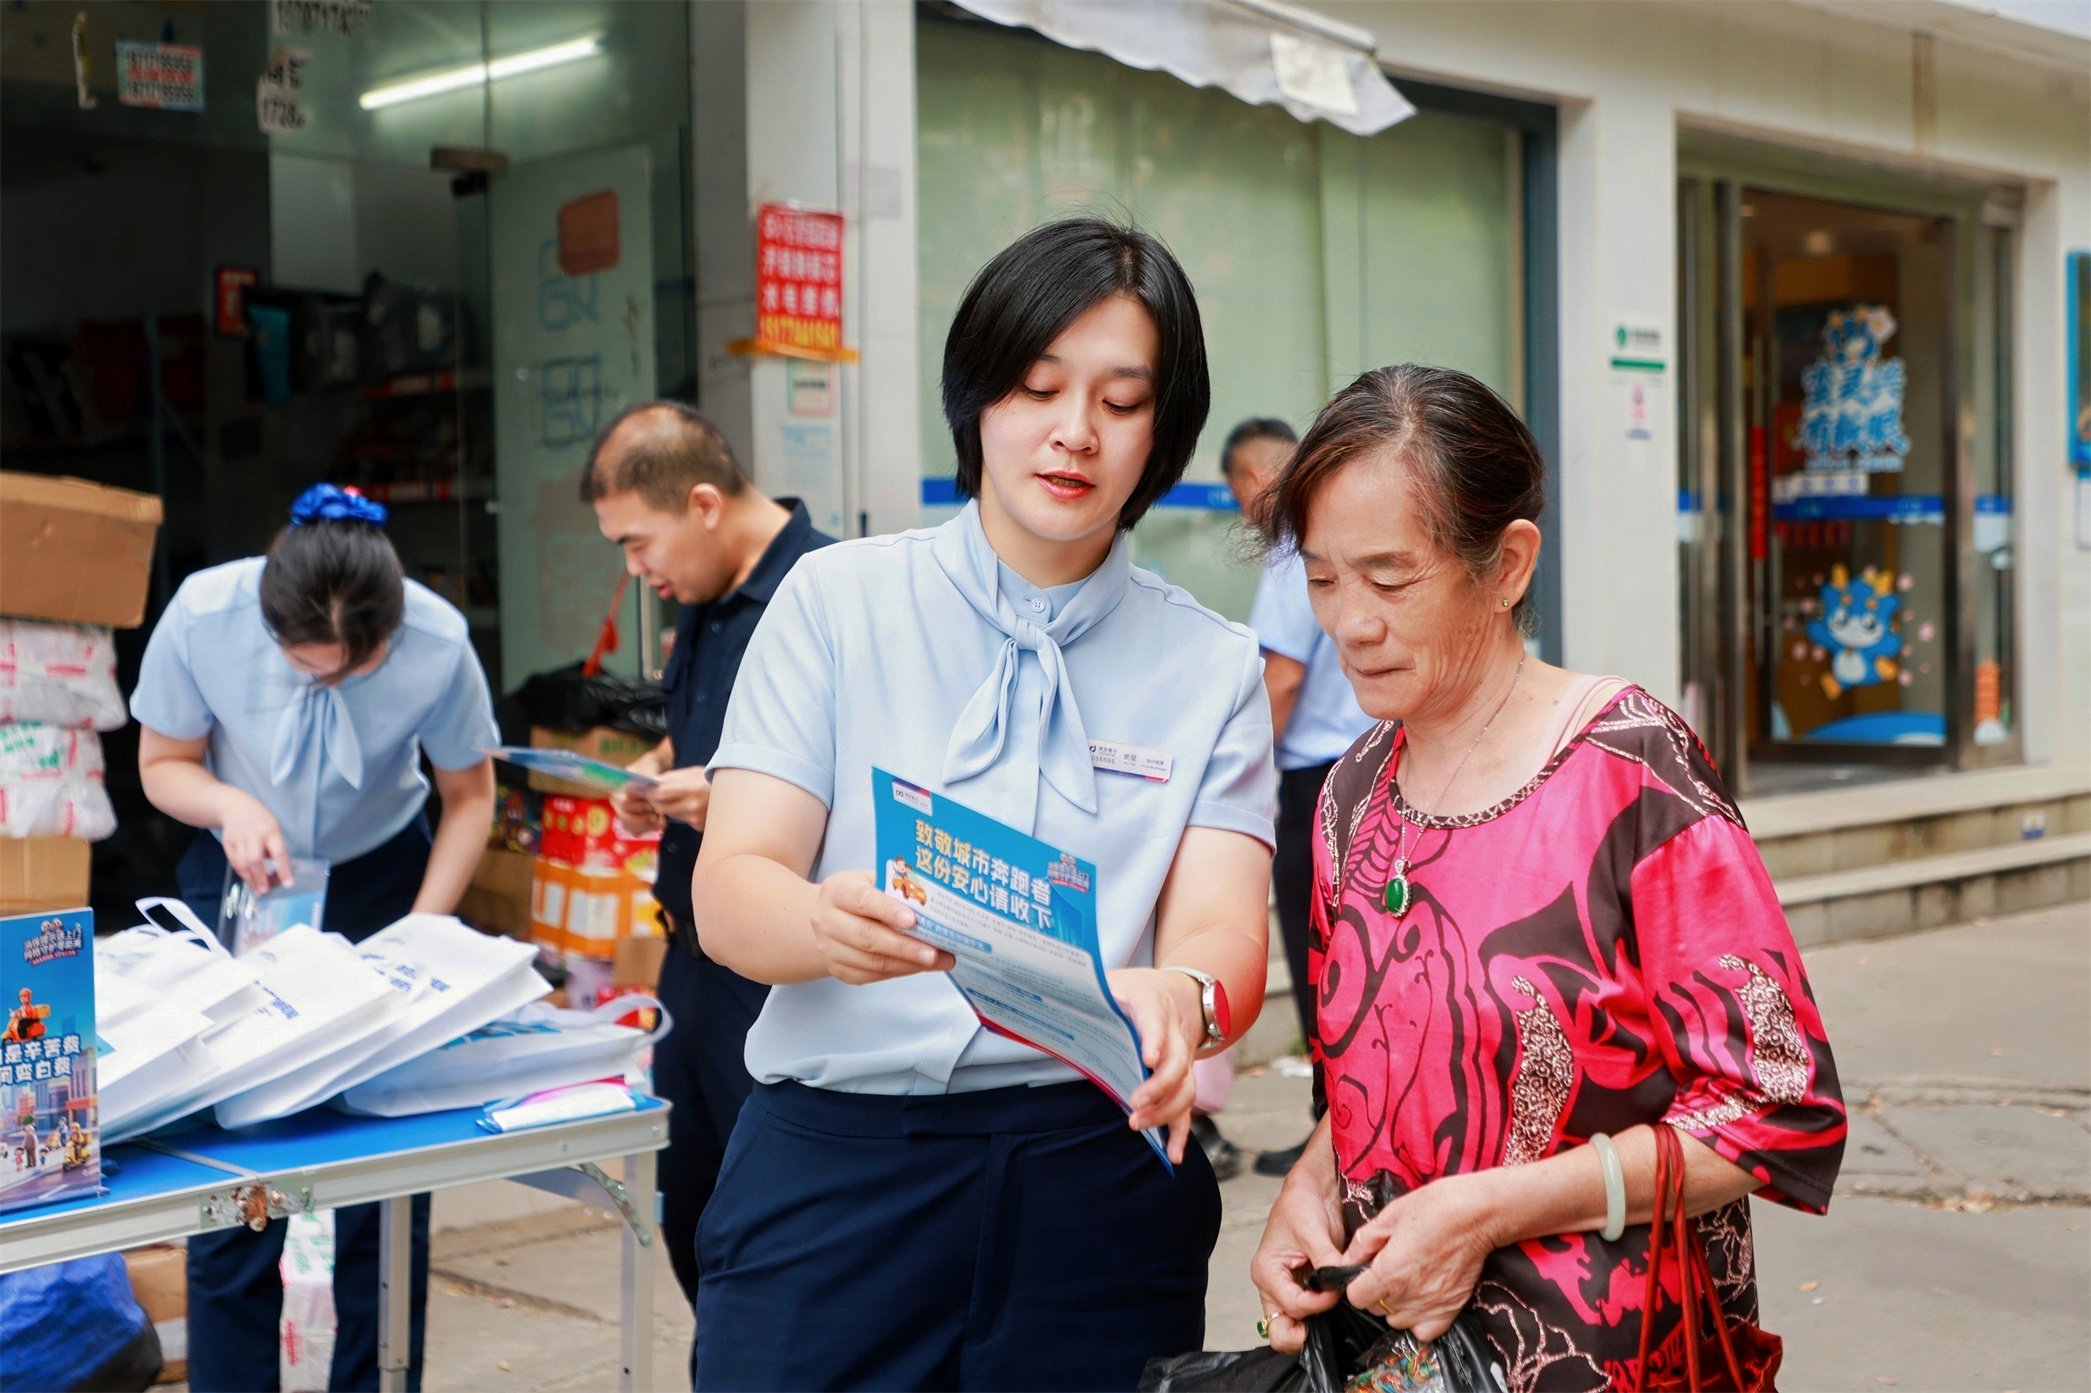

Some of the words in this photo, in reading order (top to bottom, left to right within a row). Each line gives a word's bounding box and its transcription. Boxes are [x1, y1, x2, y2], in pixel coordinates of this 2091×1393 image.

[915, 819, 1051, 906] 致敬城市奔跑者
[915, 845, 1053, 929] 这份安心请收下
[0, 1034, 80, 1064] 是辛苦费
